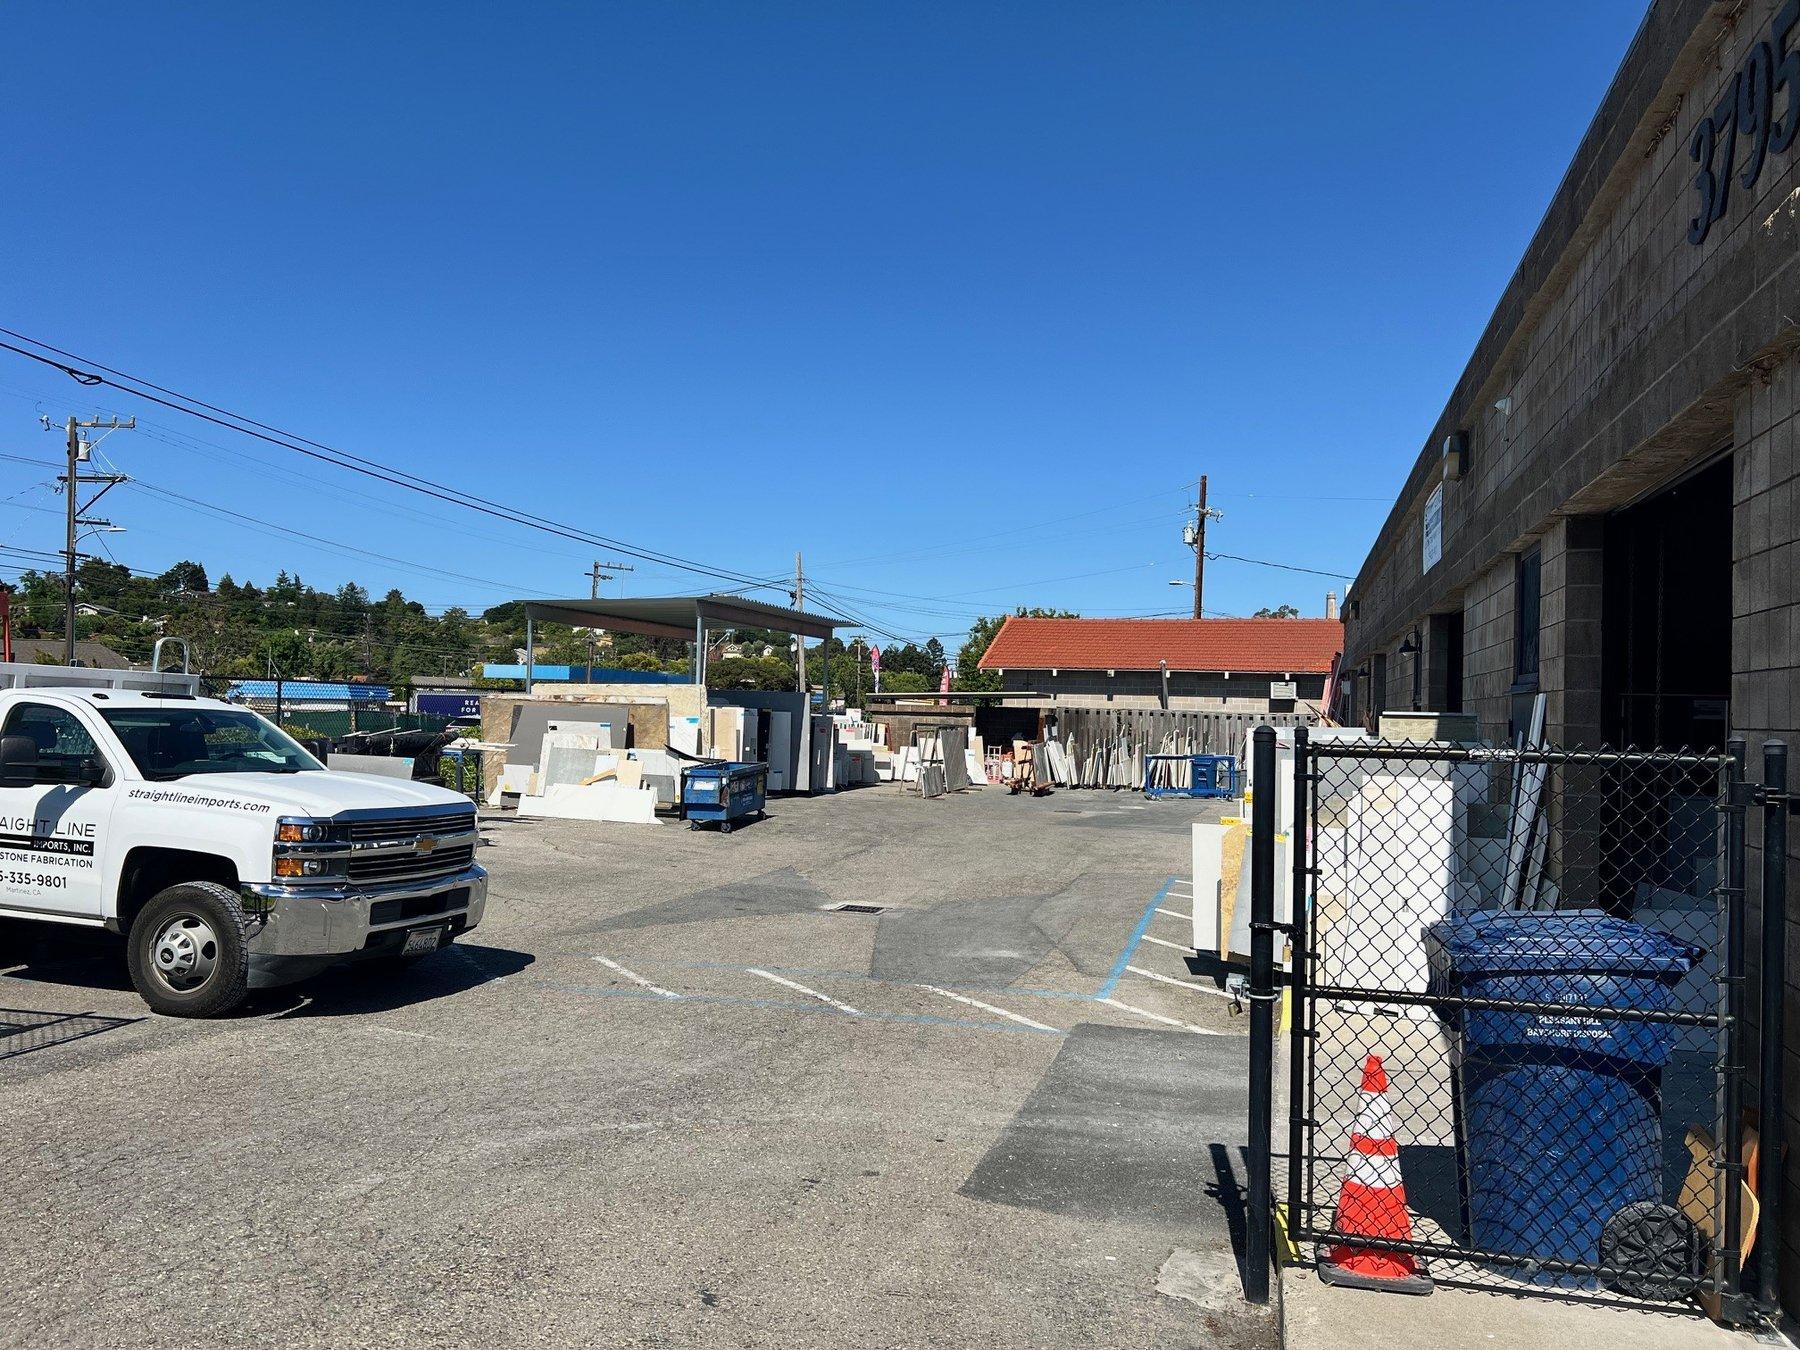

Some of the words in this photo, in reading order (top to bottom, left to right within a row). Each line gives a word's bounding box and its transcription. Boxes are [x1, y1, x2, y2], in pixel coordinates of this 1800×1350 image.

[1687, 0, 1800, 245] 3795
[128, 788, 271, 813] straightlineimports.com
[55, 820, 96, 837] LINE
[33, 840, 71, 852] IMPORTS,
[73, 843, 91, 853] INC.
[0, 851, 29, 863] STONE
[30, 854, 93, 868] FABRICATION
